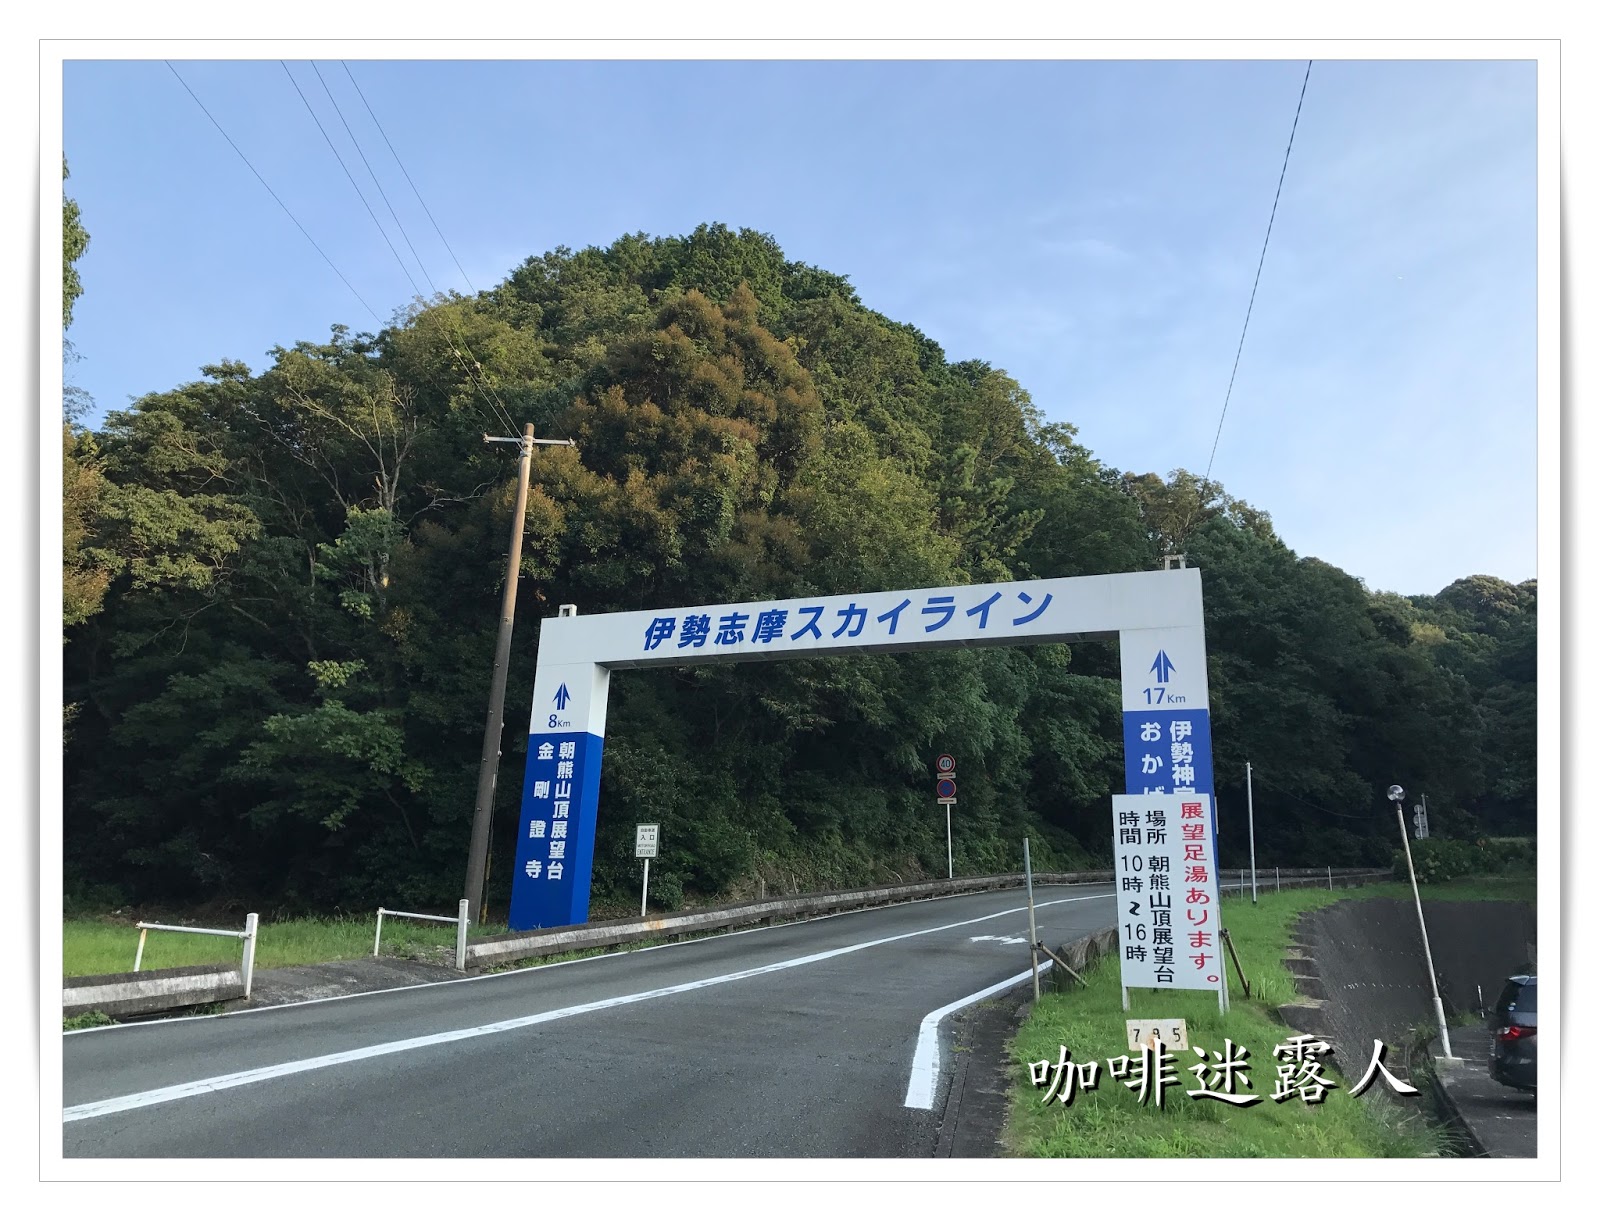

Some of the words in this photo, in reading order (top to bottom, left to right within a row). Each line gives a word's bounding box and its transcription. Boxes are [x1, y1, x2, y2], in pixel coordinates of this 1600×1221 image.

[643, 591, 1053, 651] 伊勢志摩スカイライン
[941, 760, 950, 768] 40
[525, 742, 554, 879] 金剛證寺
[547, 741, 576, 880] 朝熊山頂展望台
[1119, 811, 1141, 845] 時間
[1145, 810, 1167, 845] 場所
[1148, 855, 1175, 983] 朝熊山頂展望台
[1180, 802, 1219, 983] 展望足湯あります。
[1133, 1027, 1181, 1042] 795
